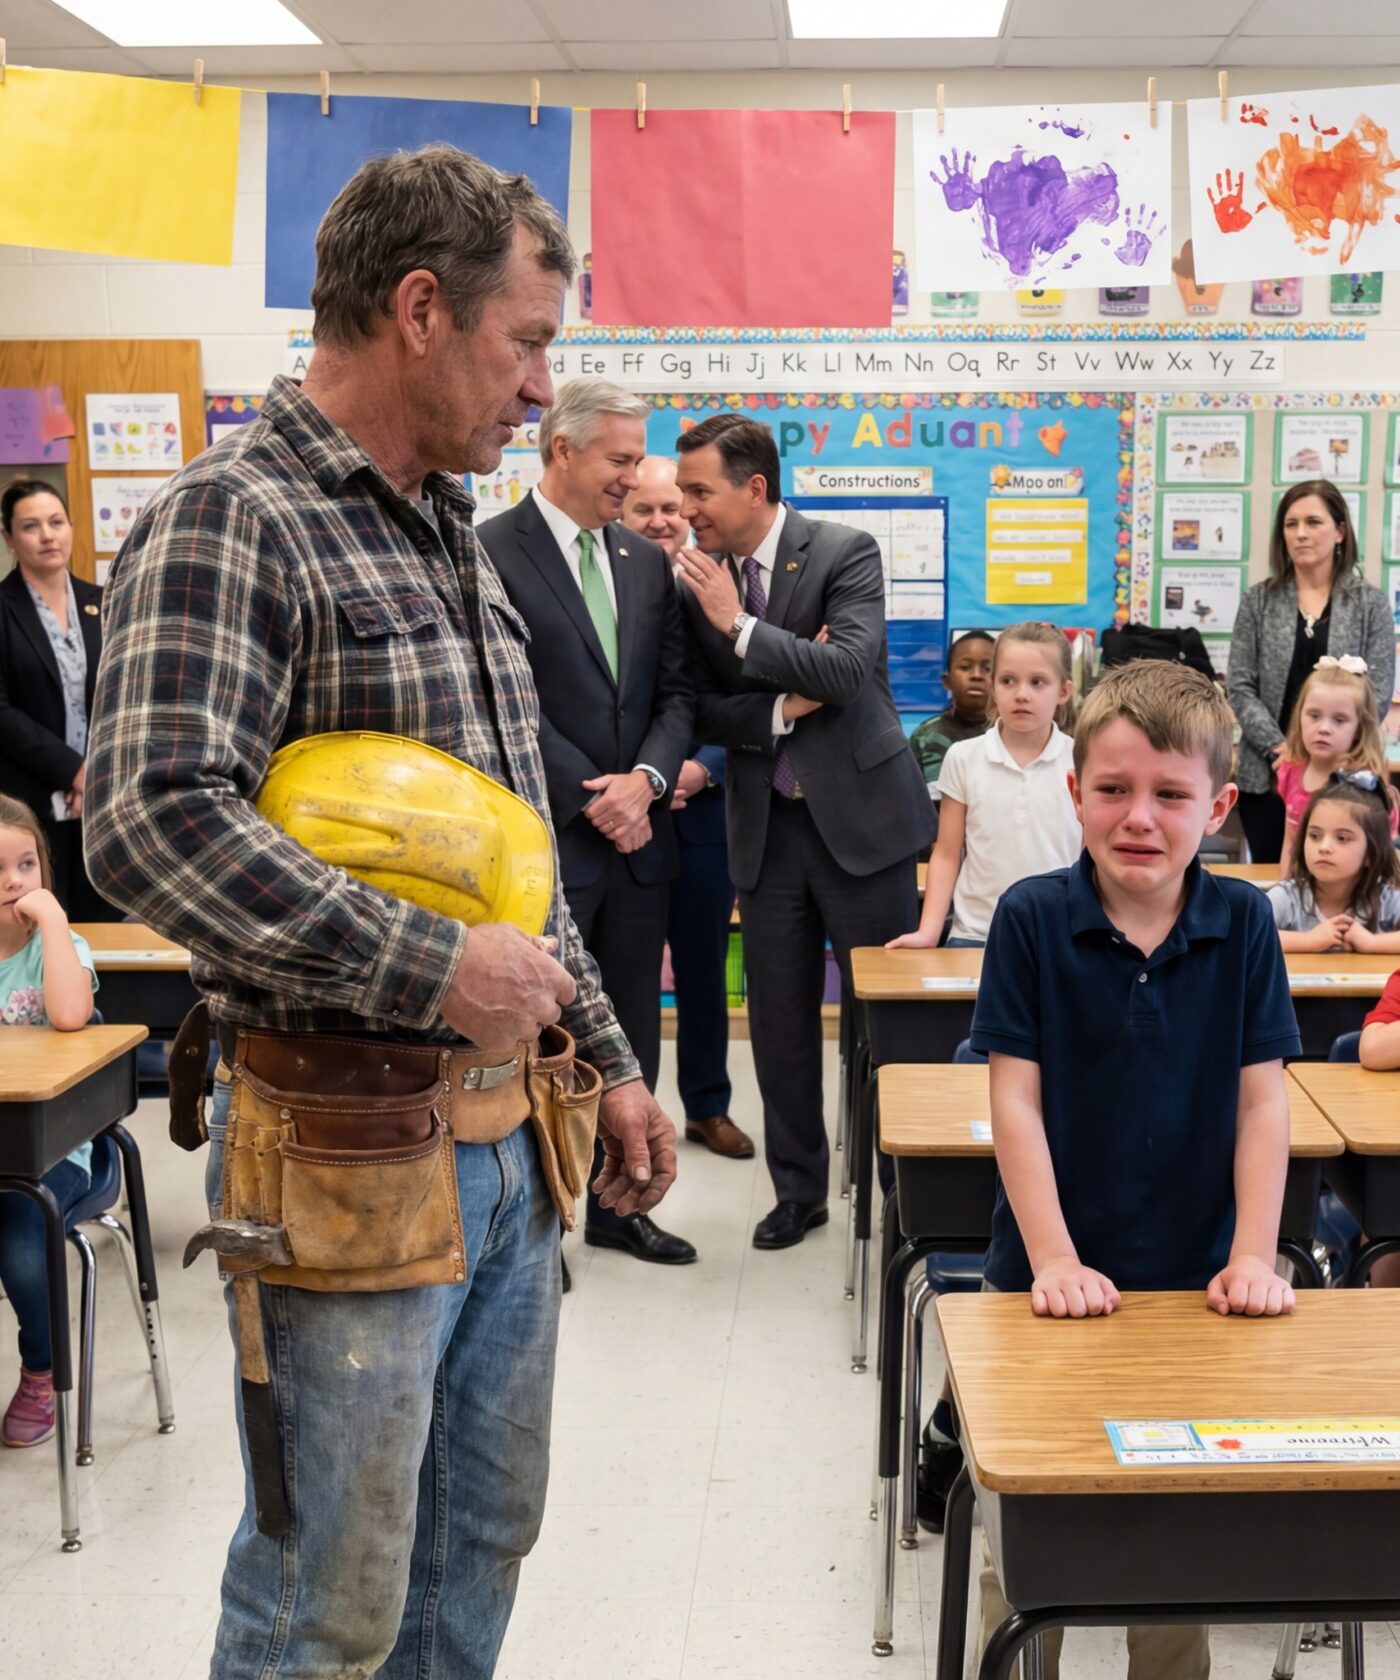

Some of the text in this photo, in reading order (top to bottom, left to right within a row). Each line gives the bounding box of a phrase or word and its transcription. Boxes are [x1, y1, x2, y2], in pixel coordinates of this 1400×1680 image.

[581, 354, 605, 373] Ee
[623, 353, 644, 373] Ff
[661, 353, 691, 379] Gg
[709, 353, 729, 372] Hi
[746, 353, 765, 379] Jj
[783, 353, 806, 372] Kk
[825, 353, 841, 372] Ll
[856, 353, 892, 372] Mm
[905, 353, 933, 372] Nn
[997, 352, 1019, 371] Rr
[1037, 352, 1056, 371] St
[1075, 352, 1100, 371] Vv
[1115, 352, 1155, 371] Ww
[1168, 352, 1192, 371] Xx
[1209, 351, 1233, 377] Yy
[1250, 350, 1275, 370] Zz
[851, 411, 1024, 449] Aduant
[818, 473, 921, 489] Constructions
[1012, 475, 1064, 489] Moo on
